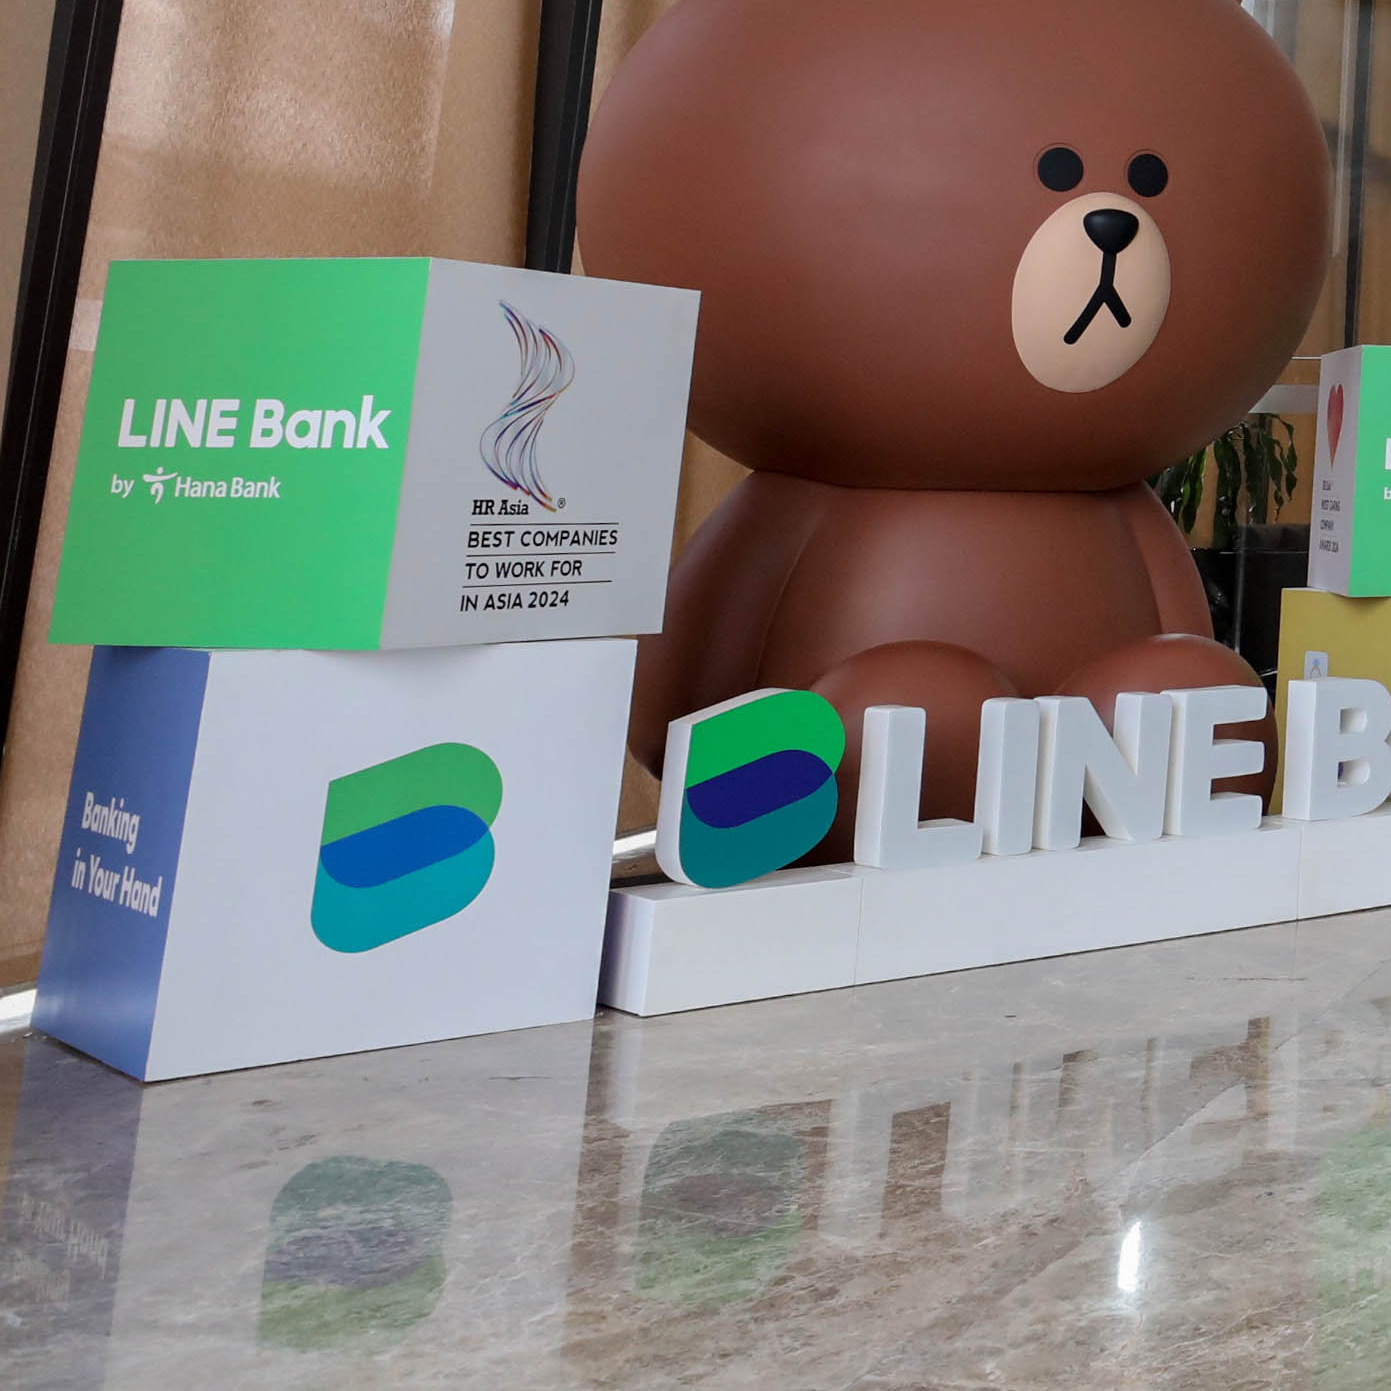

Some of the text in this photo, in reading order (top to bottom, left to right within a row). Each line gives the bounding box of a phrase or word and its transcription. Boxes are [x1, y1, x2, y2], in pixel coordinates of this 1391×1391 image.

[118, 394, 392, 448] LINE Bank
[111, 474, 281, 498] by Hana Bank
[471, 499, 529, 515] HR Asia
[467, 529, 619, 548] BEST COMPANIES
[465, 560, 583, 580] TO WORK FOR
[460, 590, 570, 612] IN ASIA 2024
[854, 685, 1268, 869] LINE
[81, 791, 141, 855] Banking
[71, 847, 163, 918] in Your Hand
